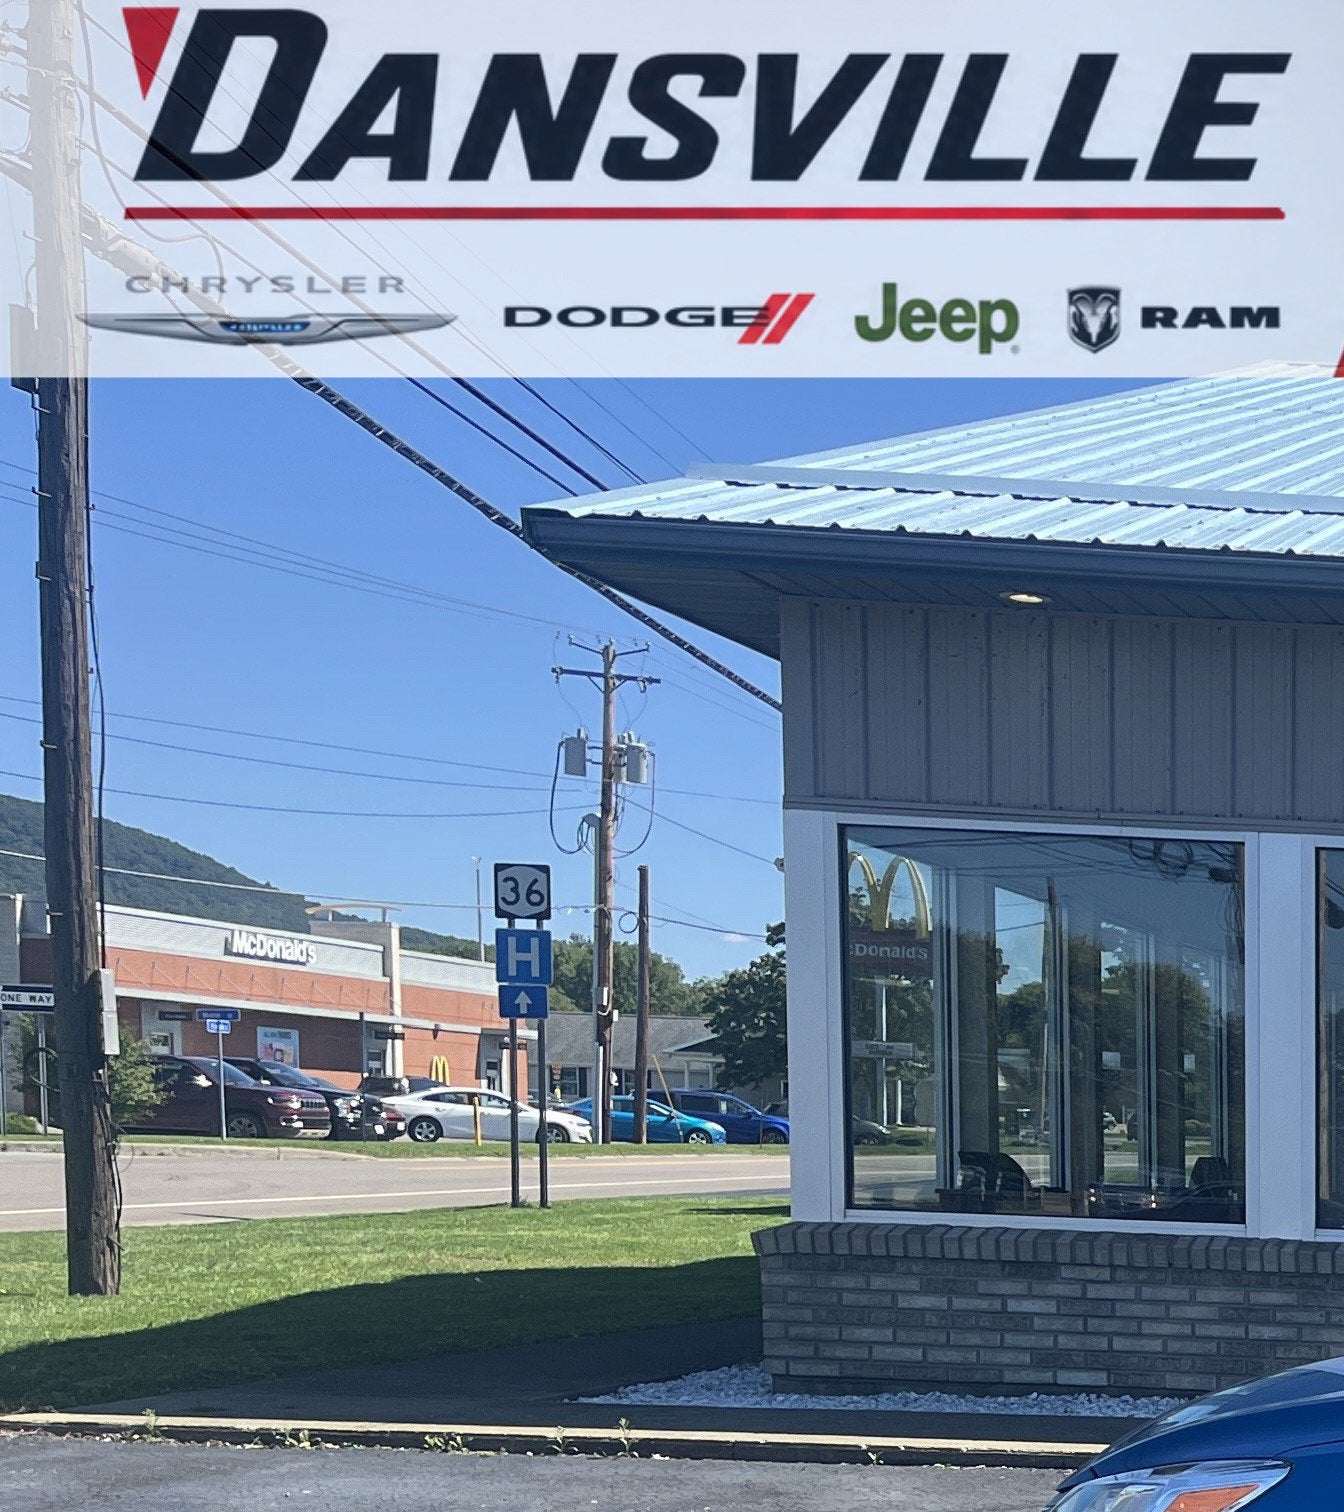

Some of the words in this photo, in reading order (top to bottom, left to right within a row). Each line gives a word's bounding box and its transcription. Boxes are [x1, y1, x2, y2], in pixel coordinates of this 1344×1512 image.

[501, 876, 546, 908] 36
[232, 929, 318, 965] McDonald's
[507, 936, 540, 978] H
[0, 993, 22, 1003] ONE
[28, 995, 53, 1003] WAY
